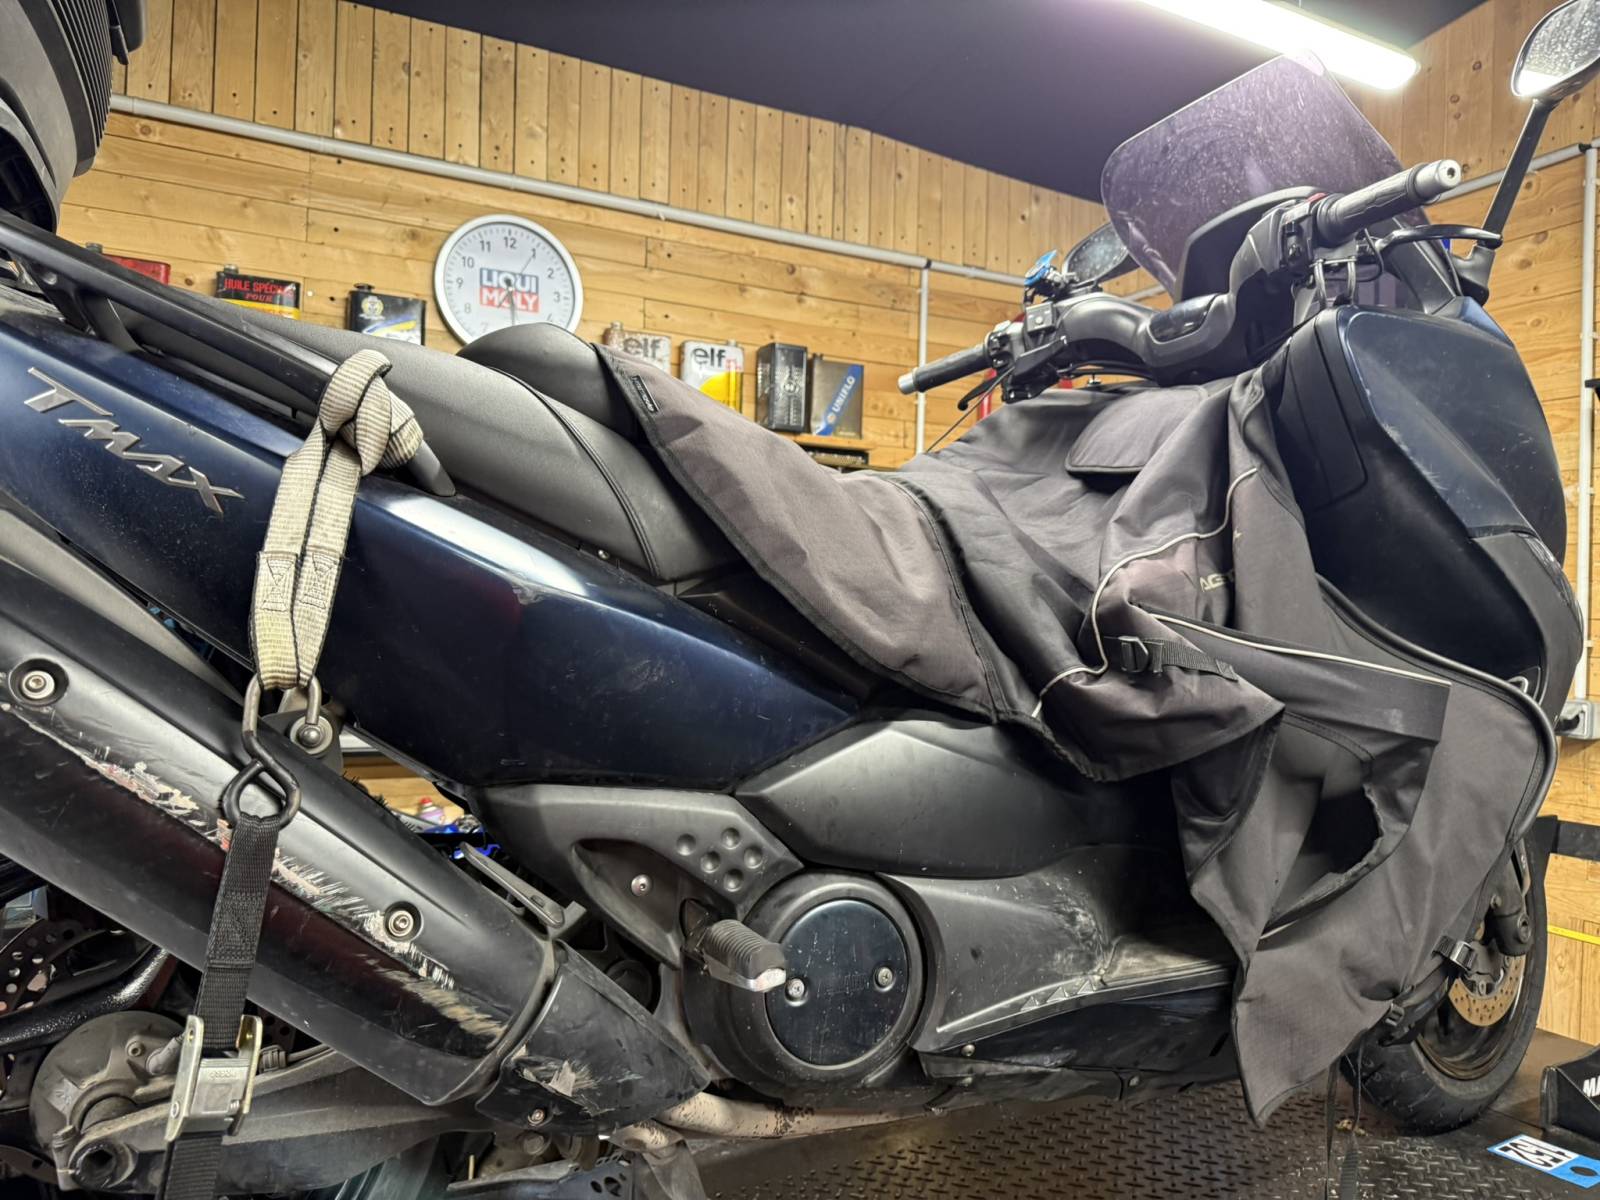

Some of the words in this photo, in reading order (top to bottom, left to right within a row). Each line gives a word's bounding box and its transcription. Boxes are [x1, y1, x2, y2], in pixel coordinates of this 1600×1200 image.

[480, 240, 491, 252] 11
[503, 236, 517, 250] 12
[531, 248, 536, 259] 1
[461, 256, 475, 269] 10
[547, 268, 555, 279] 2
[224, 278, 250, 291] HUILE
[456, 277, 464, 289] 9
[553, 291, 561, 303] 3
[464, 303, 472, 314] 8
[623, 338, 661, 359] elf
[691, 347, 726, 367] elf
[831, 375, 856, 413] UNIFLO
[1499, 1138, 1572, 1168] 152
